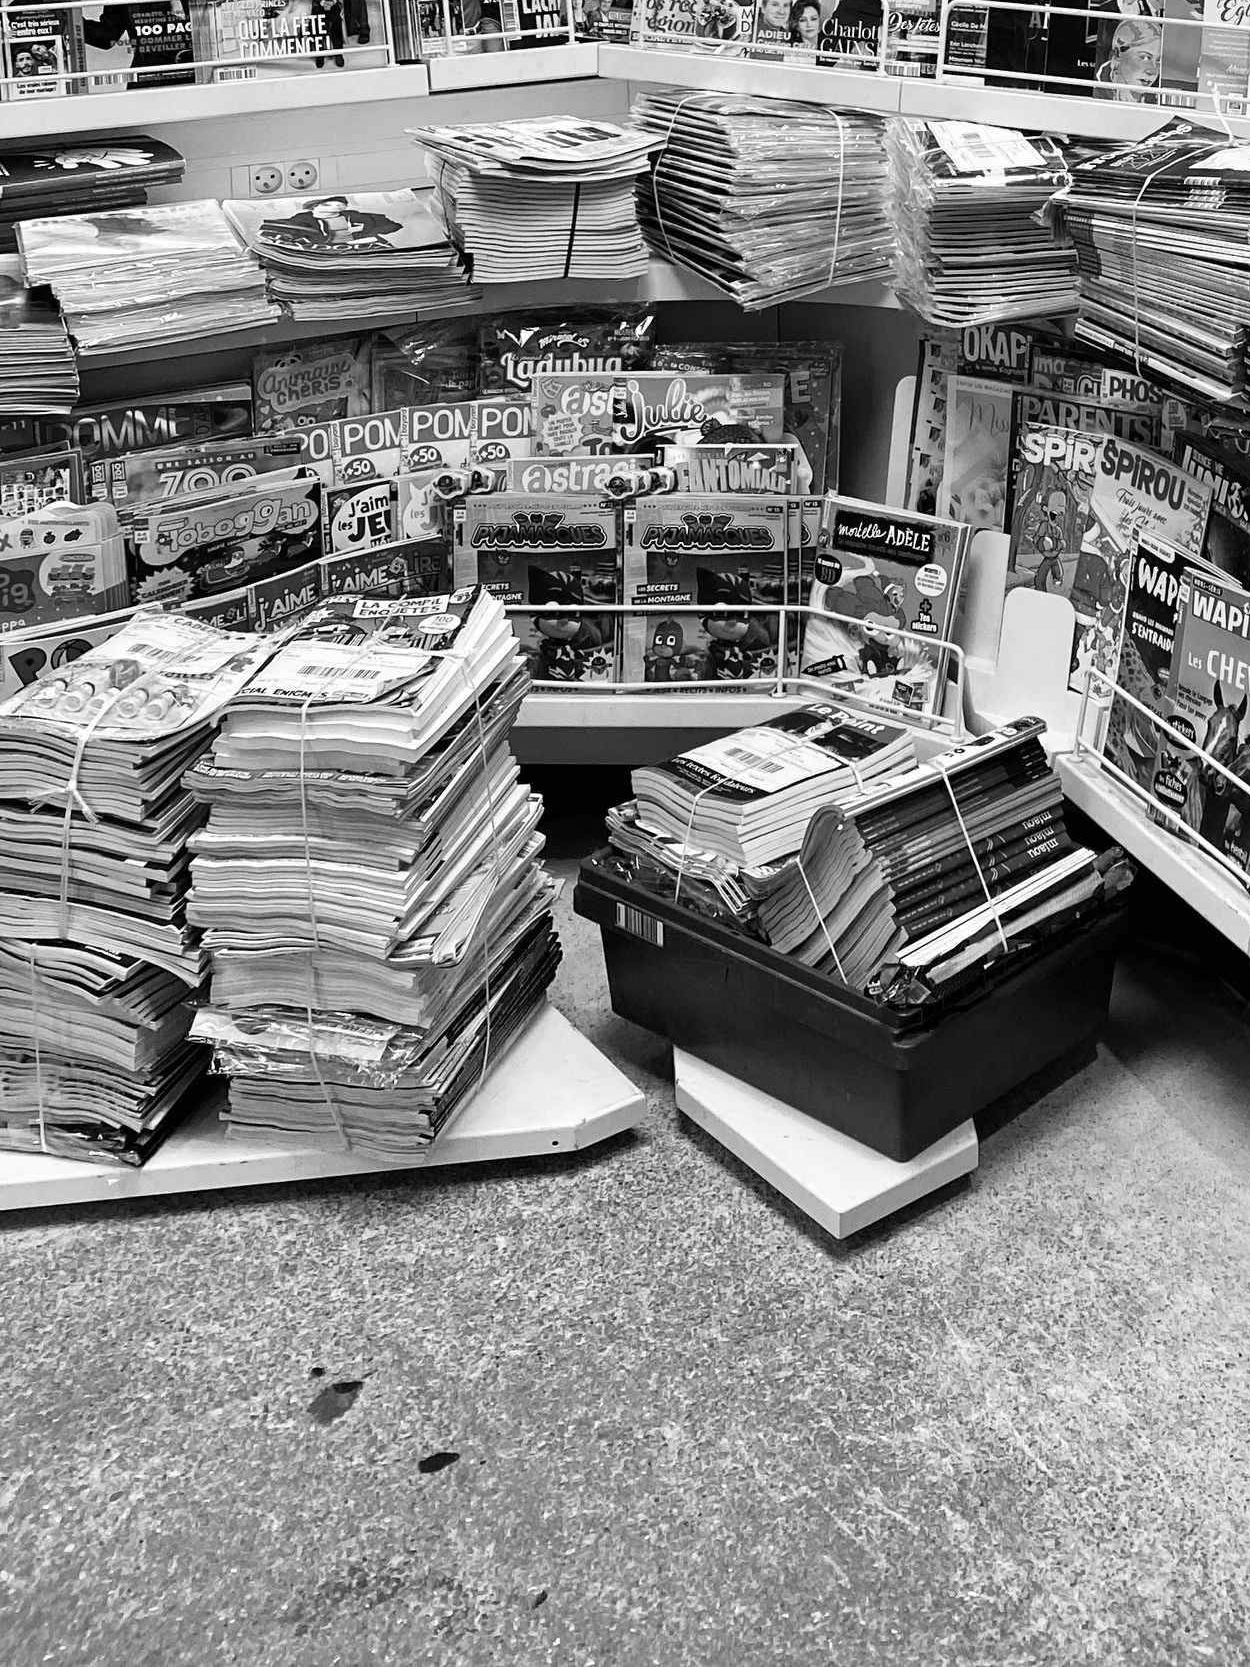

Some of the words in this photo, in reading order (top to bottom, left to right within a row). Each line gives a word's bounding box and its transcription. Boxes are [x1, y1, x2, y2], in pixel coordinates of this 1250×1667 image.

[619, 378, 708, 443] Julie
[160, 494, 312, 548] Toboggan
[640, 523, 775, 549] PYJAMASQUES
[838, 523, 885, 540] mortelle
[886, 525, 930, 552] ADÈLE
[811, 703, 831, 716] Le
[829, 709, 886, 735] Point
